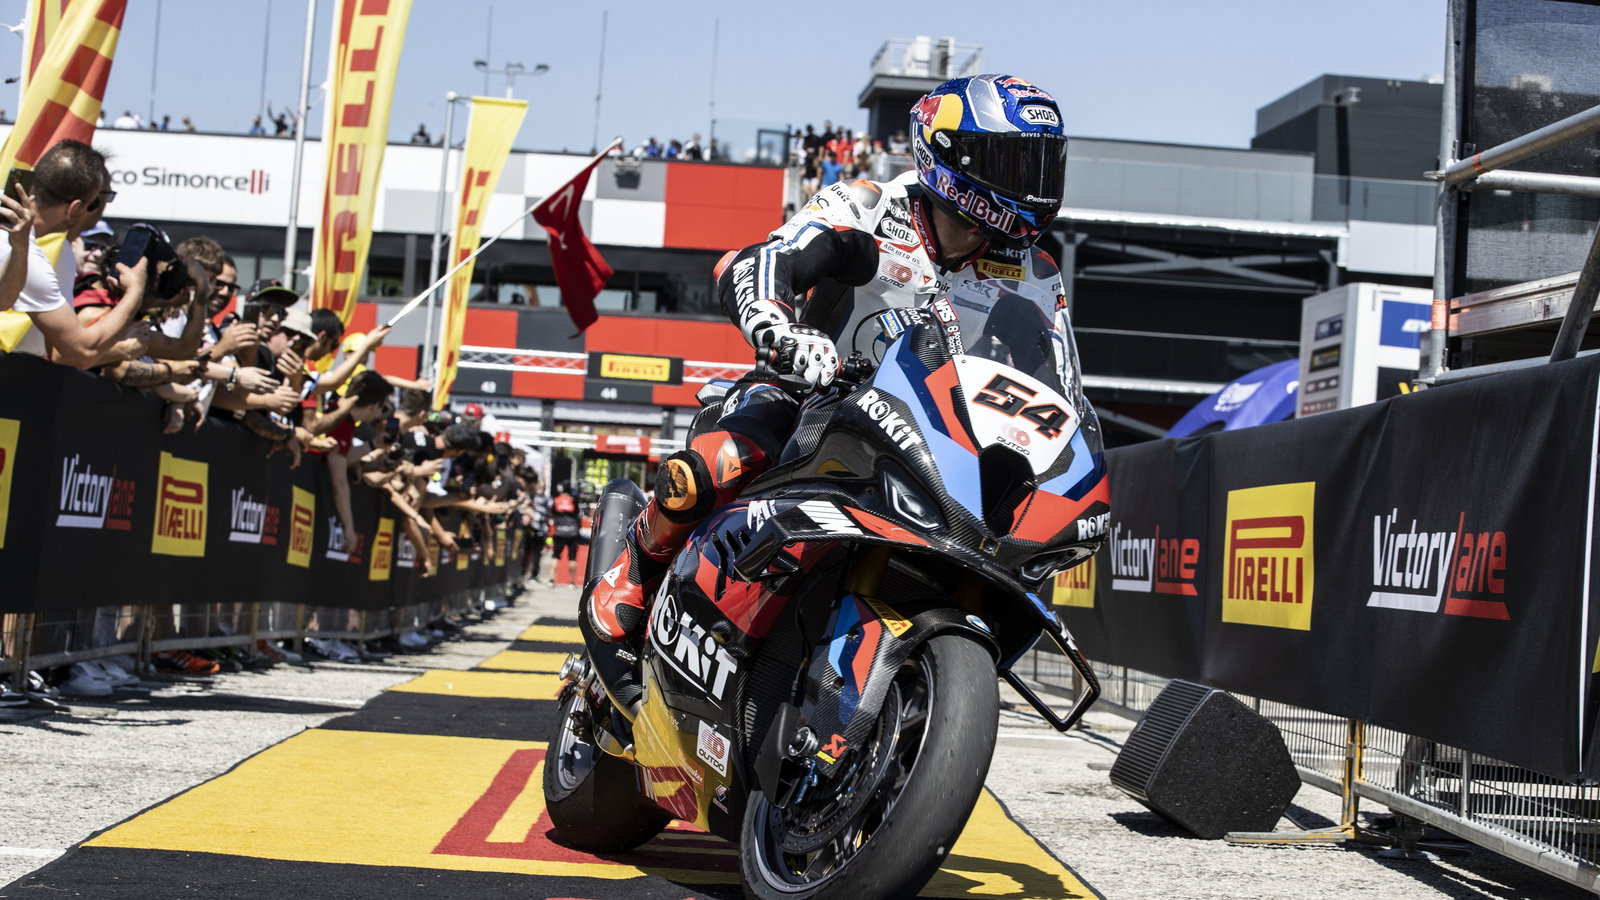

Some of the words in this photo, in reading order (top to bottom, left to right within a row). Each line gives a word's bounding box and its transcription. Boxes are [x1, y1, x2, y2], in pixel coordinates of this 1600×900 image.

[1027, 109, 1057, 122] SHOEI
[914, 136, 934, 168] SHOEI
[142, 166, 270, 194] Simoncelli
[936, 171, 974, 212] Red
[970, 190, 1017, 234] Bull
[886, 221, 916, 243] SHOEI
[982, 262, 1022, 278] PIRELLI
[934, 297, 959, 323] WRS
[856, 388, 923, 451] ROKiT
[972, 373, 1071, 441] 54
[996, 436, 1031, 456] OUTDO
[57, 453, 114, 528] Victory
[1110, 521, 1156, 593] Victory
[1229, 515, 1305, 604] PIRELLI
[1367, 507, 1457, 613] Victory
[699, 748, 725, 772] OUTDO
